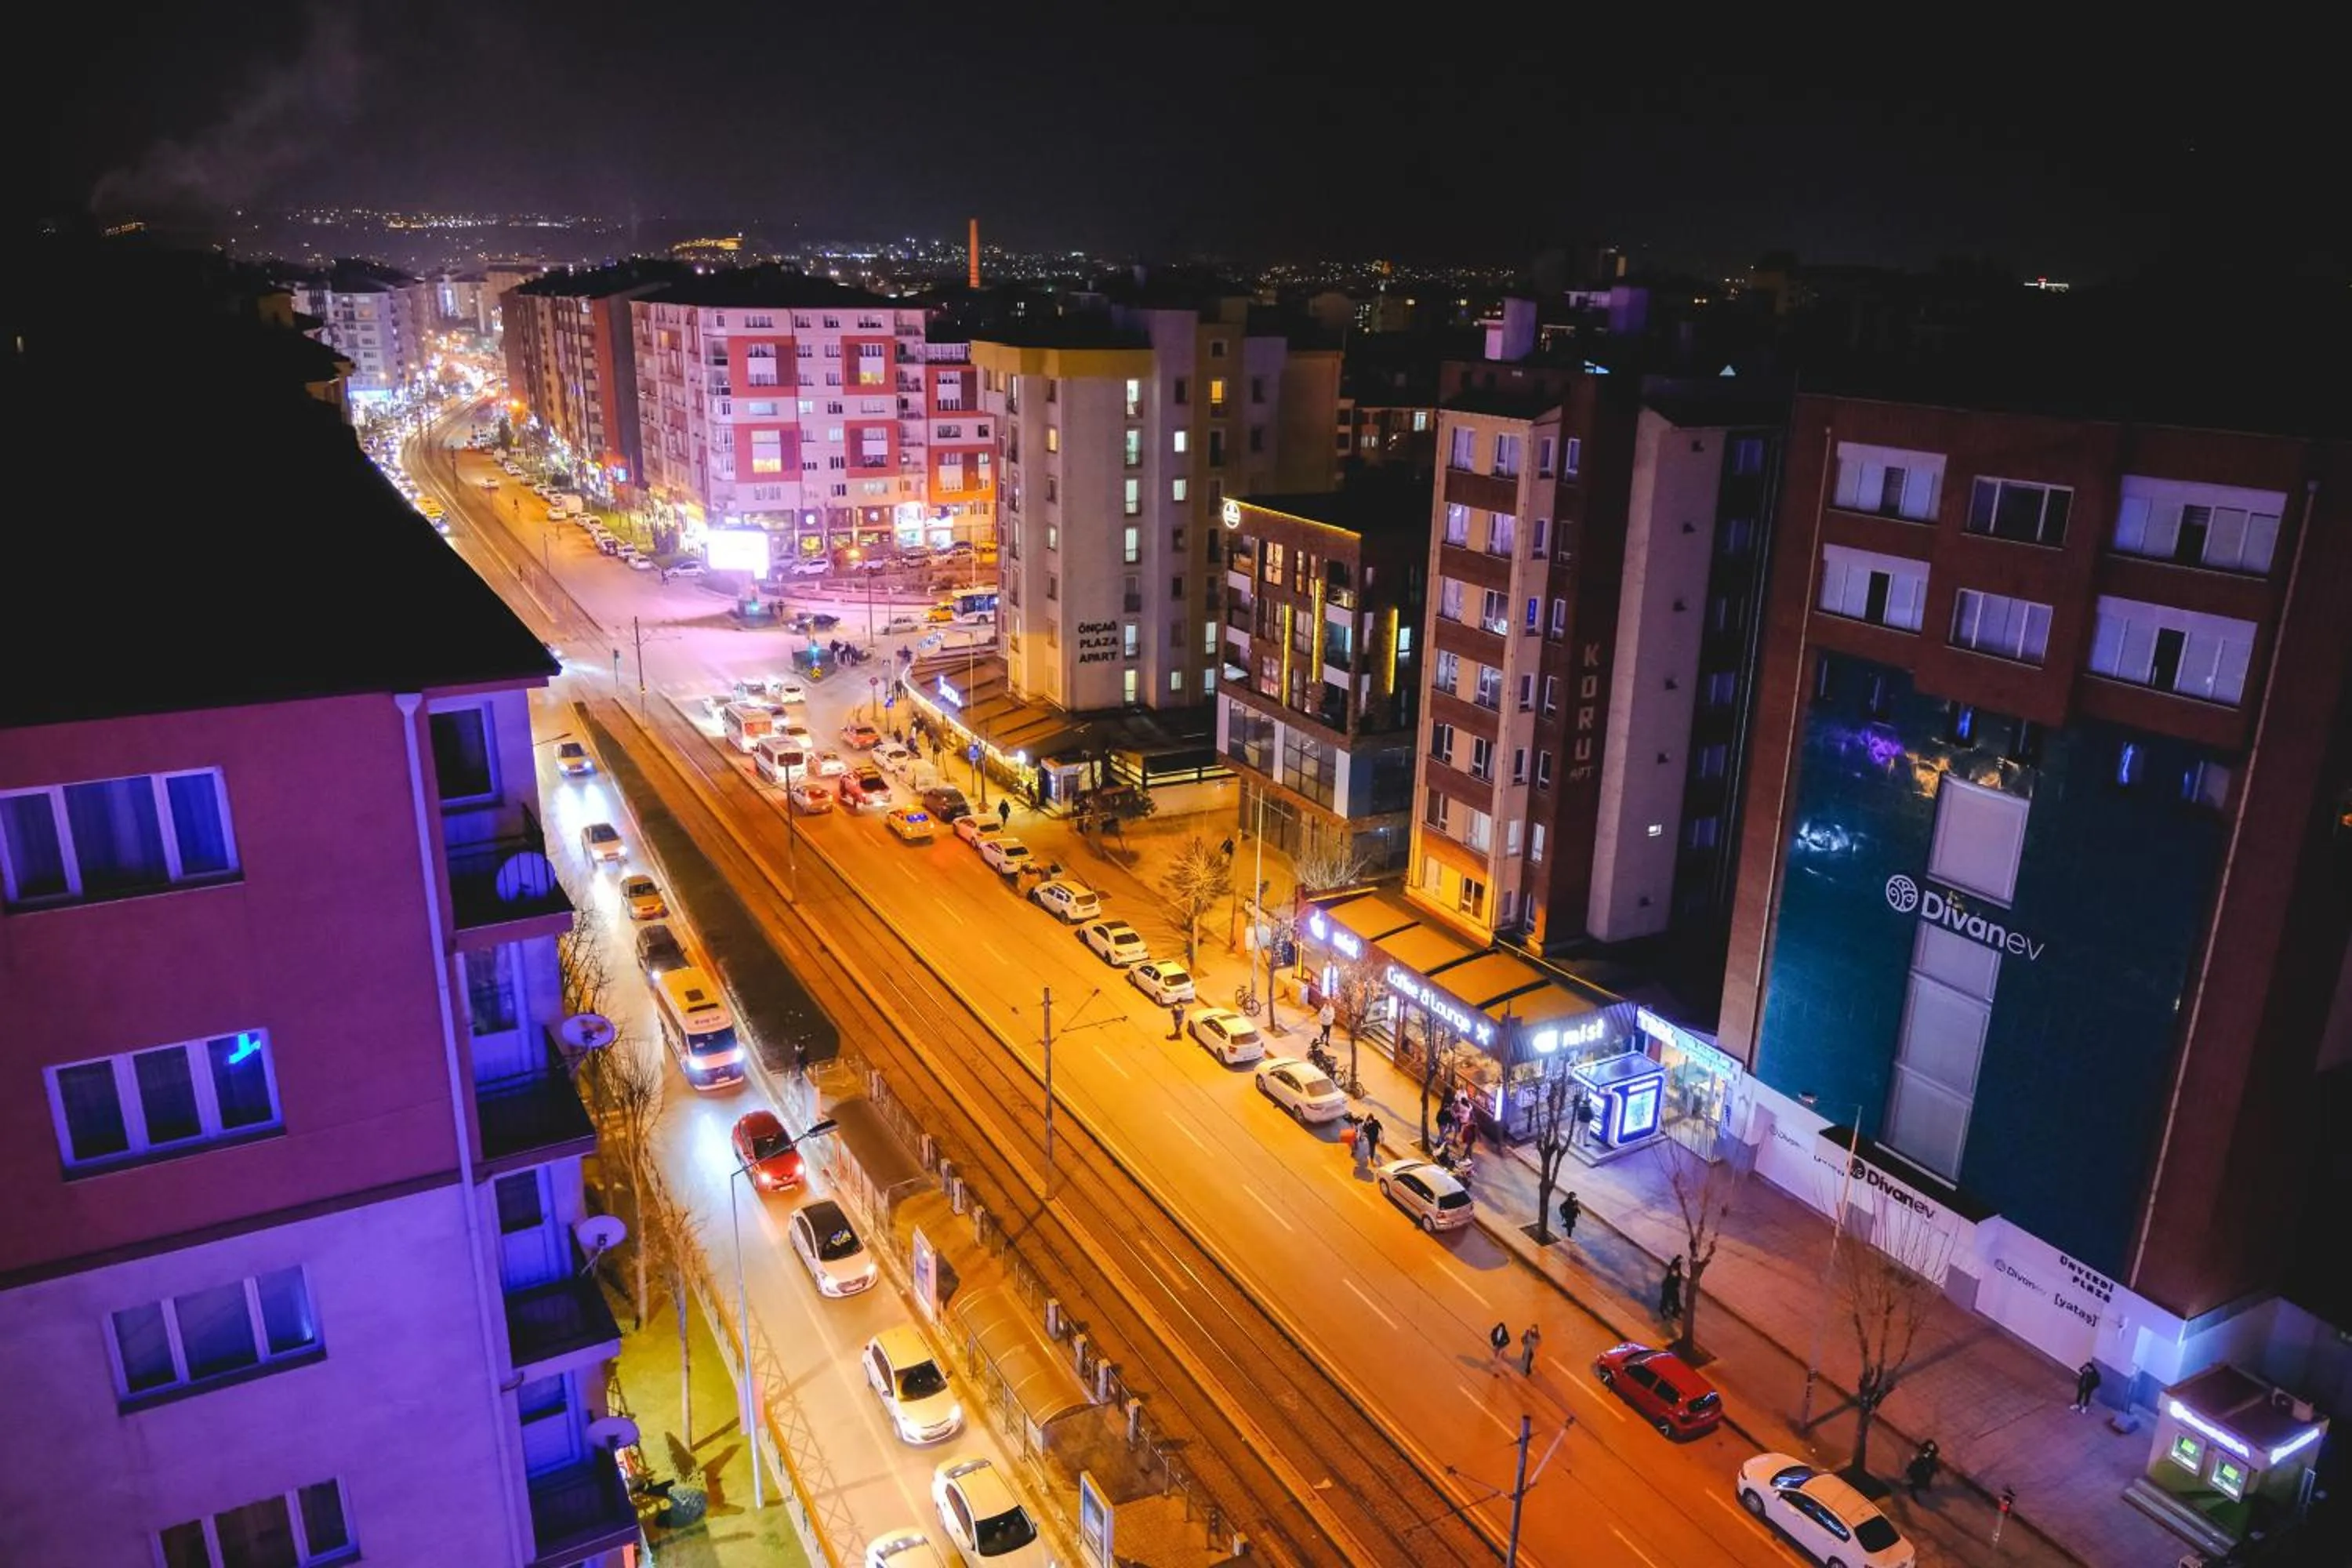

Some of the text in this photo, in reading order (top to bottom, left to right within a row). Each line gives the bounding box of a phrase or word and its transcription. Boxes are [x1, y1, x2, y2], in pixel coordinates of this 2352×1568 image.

[1078, 652, 1117, 664] APART
[1079, 637, 1119, 649] PLAZA
[1574, 642, 1600, 761] KORU
[1921, 890, 2045, 960] Divanev
[1431, 993, 1472, 1034] Lounge
[1867, 1169, 1935, 1218] Divanev
[2072, 1275, 2111, 1304] PLAZA
